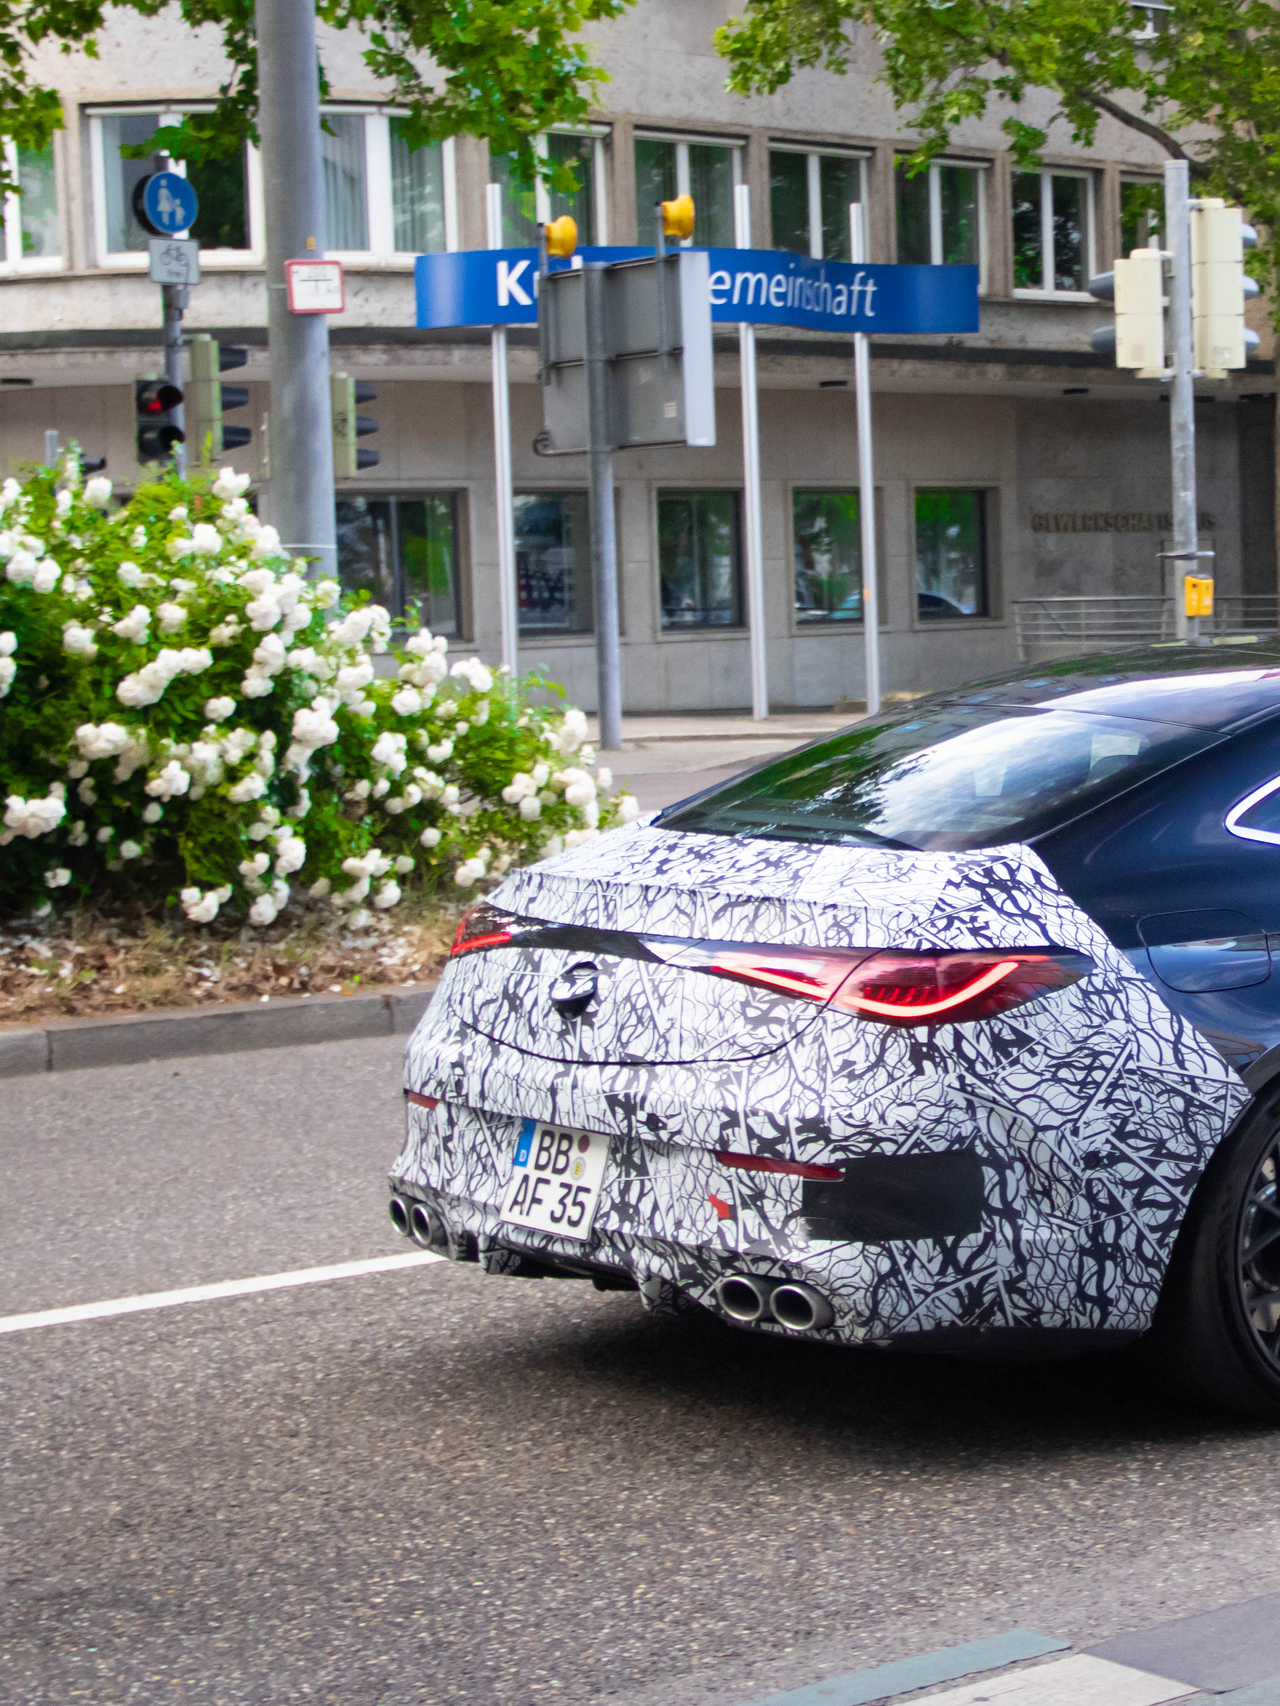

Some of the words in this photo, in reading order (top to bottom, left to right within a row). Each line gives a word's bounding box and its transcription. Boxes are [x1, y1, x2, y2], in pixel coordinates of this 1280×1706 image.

[708, 262, 878, 317] emeinschaft
[519, 1149, 527, 1162] D
[534, 1129, 573, 1175] BB
[508, 1174, 551, 1217] AF
[550, 1182, 592, 1228] 35
